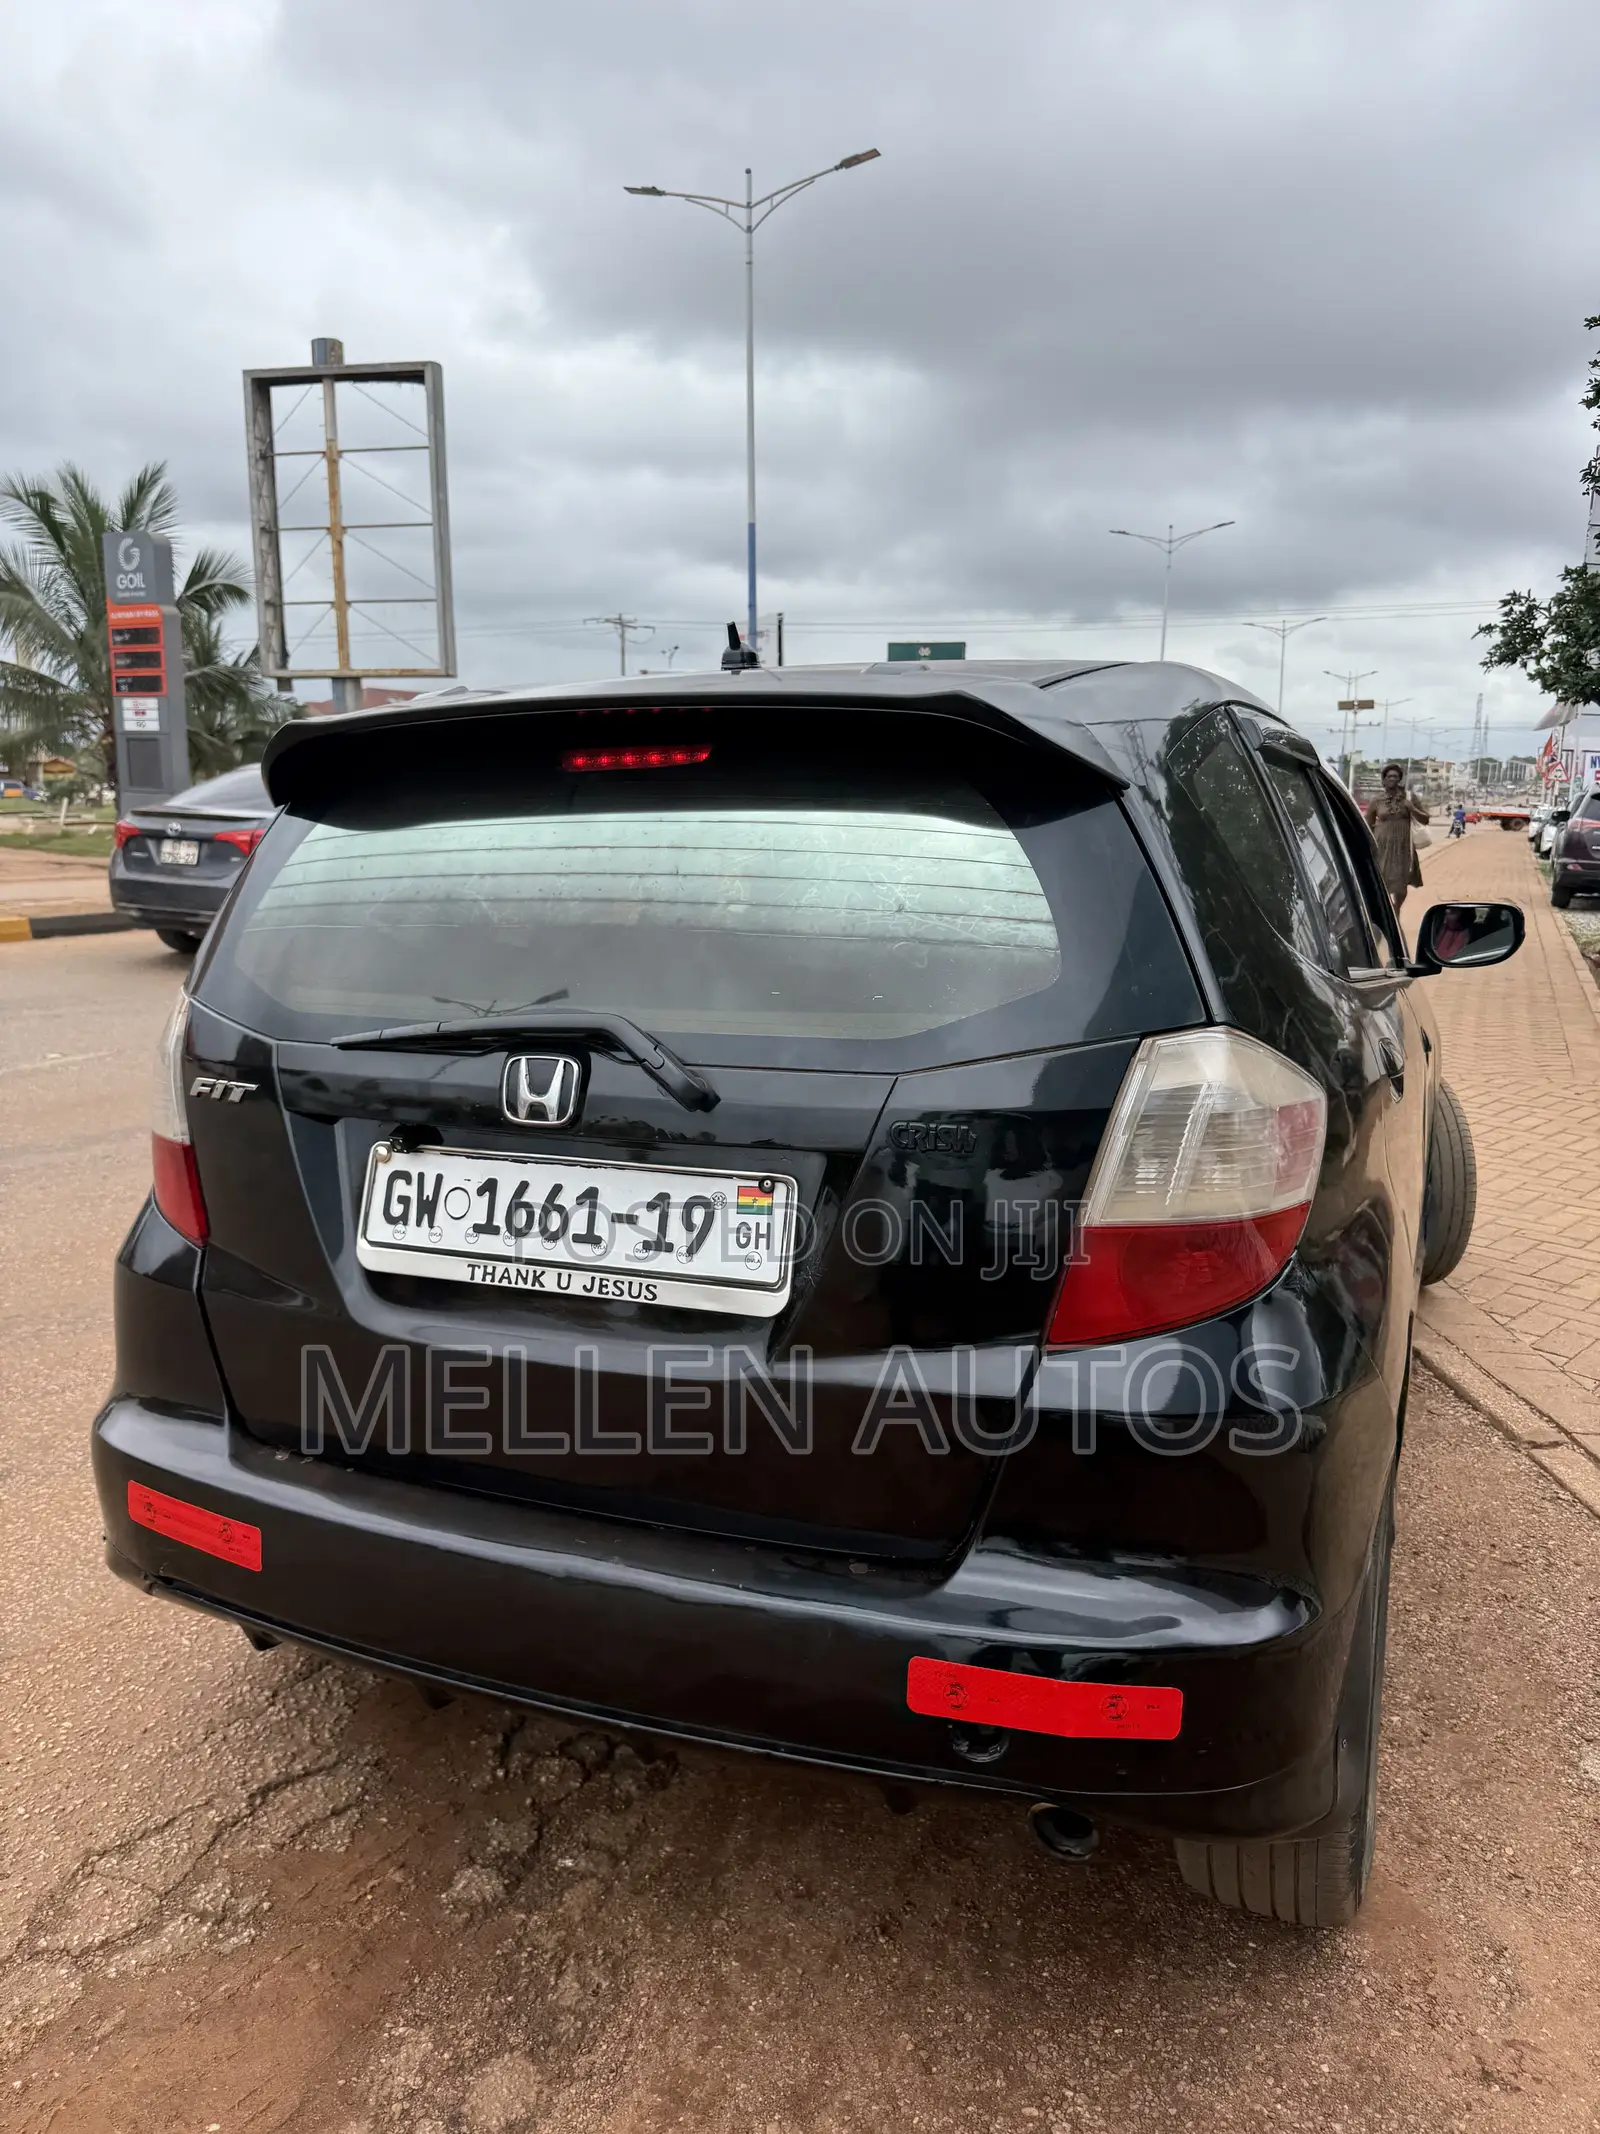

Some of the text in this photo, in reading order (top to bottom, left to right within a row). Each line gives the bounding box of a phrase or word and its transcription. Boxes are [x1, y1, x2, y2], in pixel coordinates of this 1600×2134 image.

[116, 572, 146, 589] GOIL
[189, 1077, 260, 1103] FIT
[383, 1170, 717, 1255] GW 1661-19
[736, 1221, 771, 1251] GH
[467, 1263, 658, 1302] THANK U JESUS
